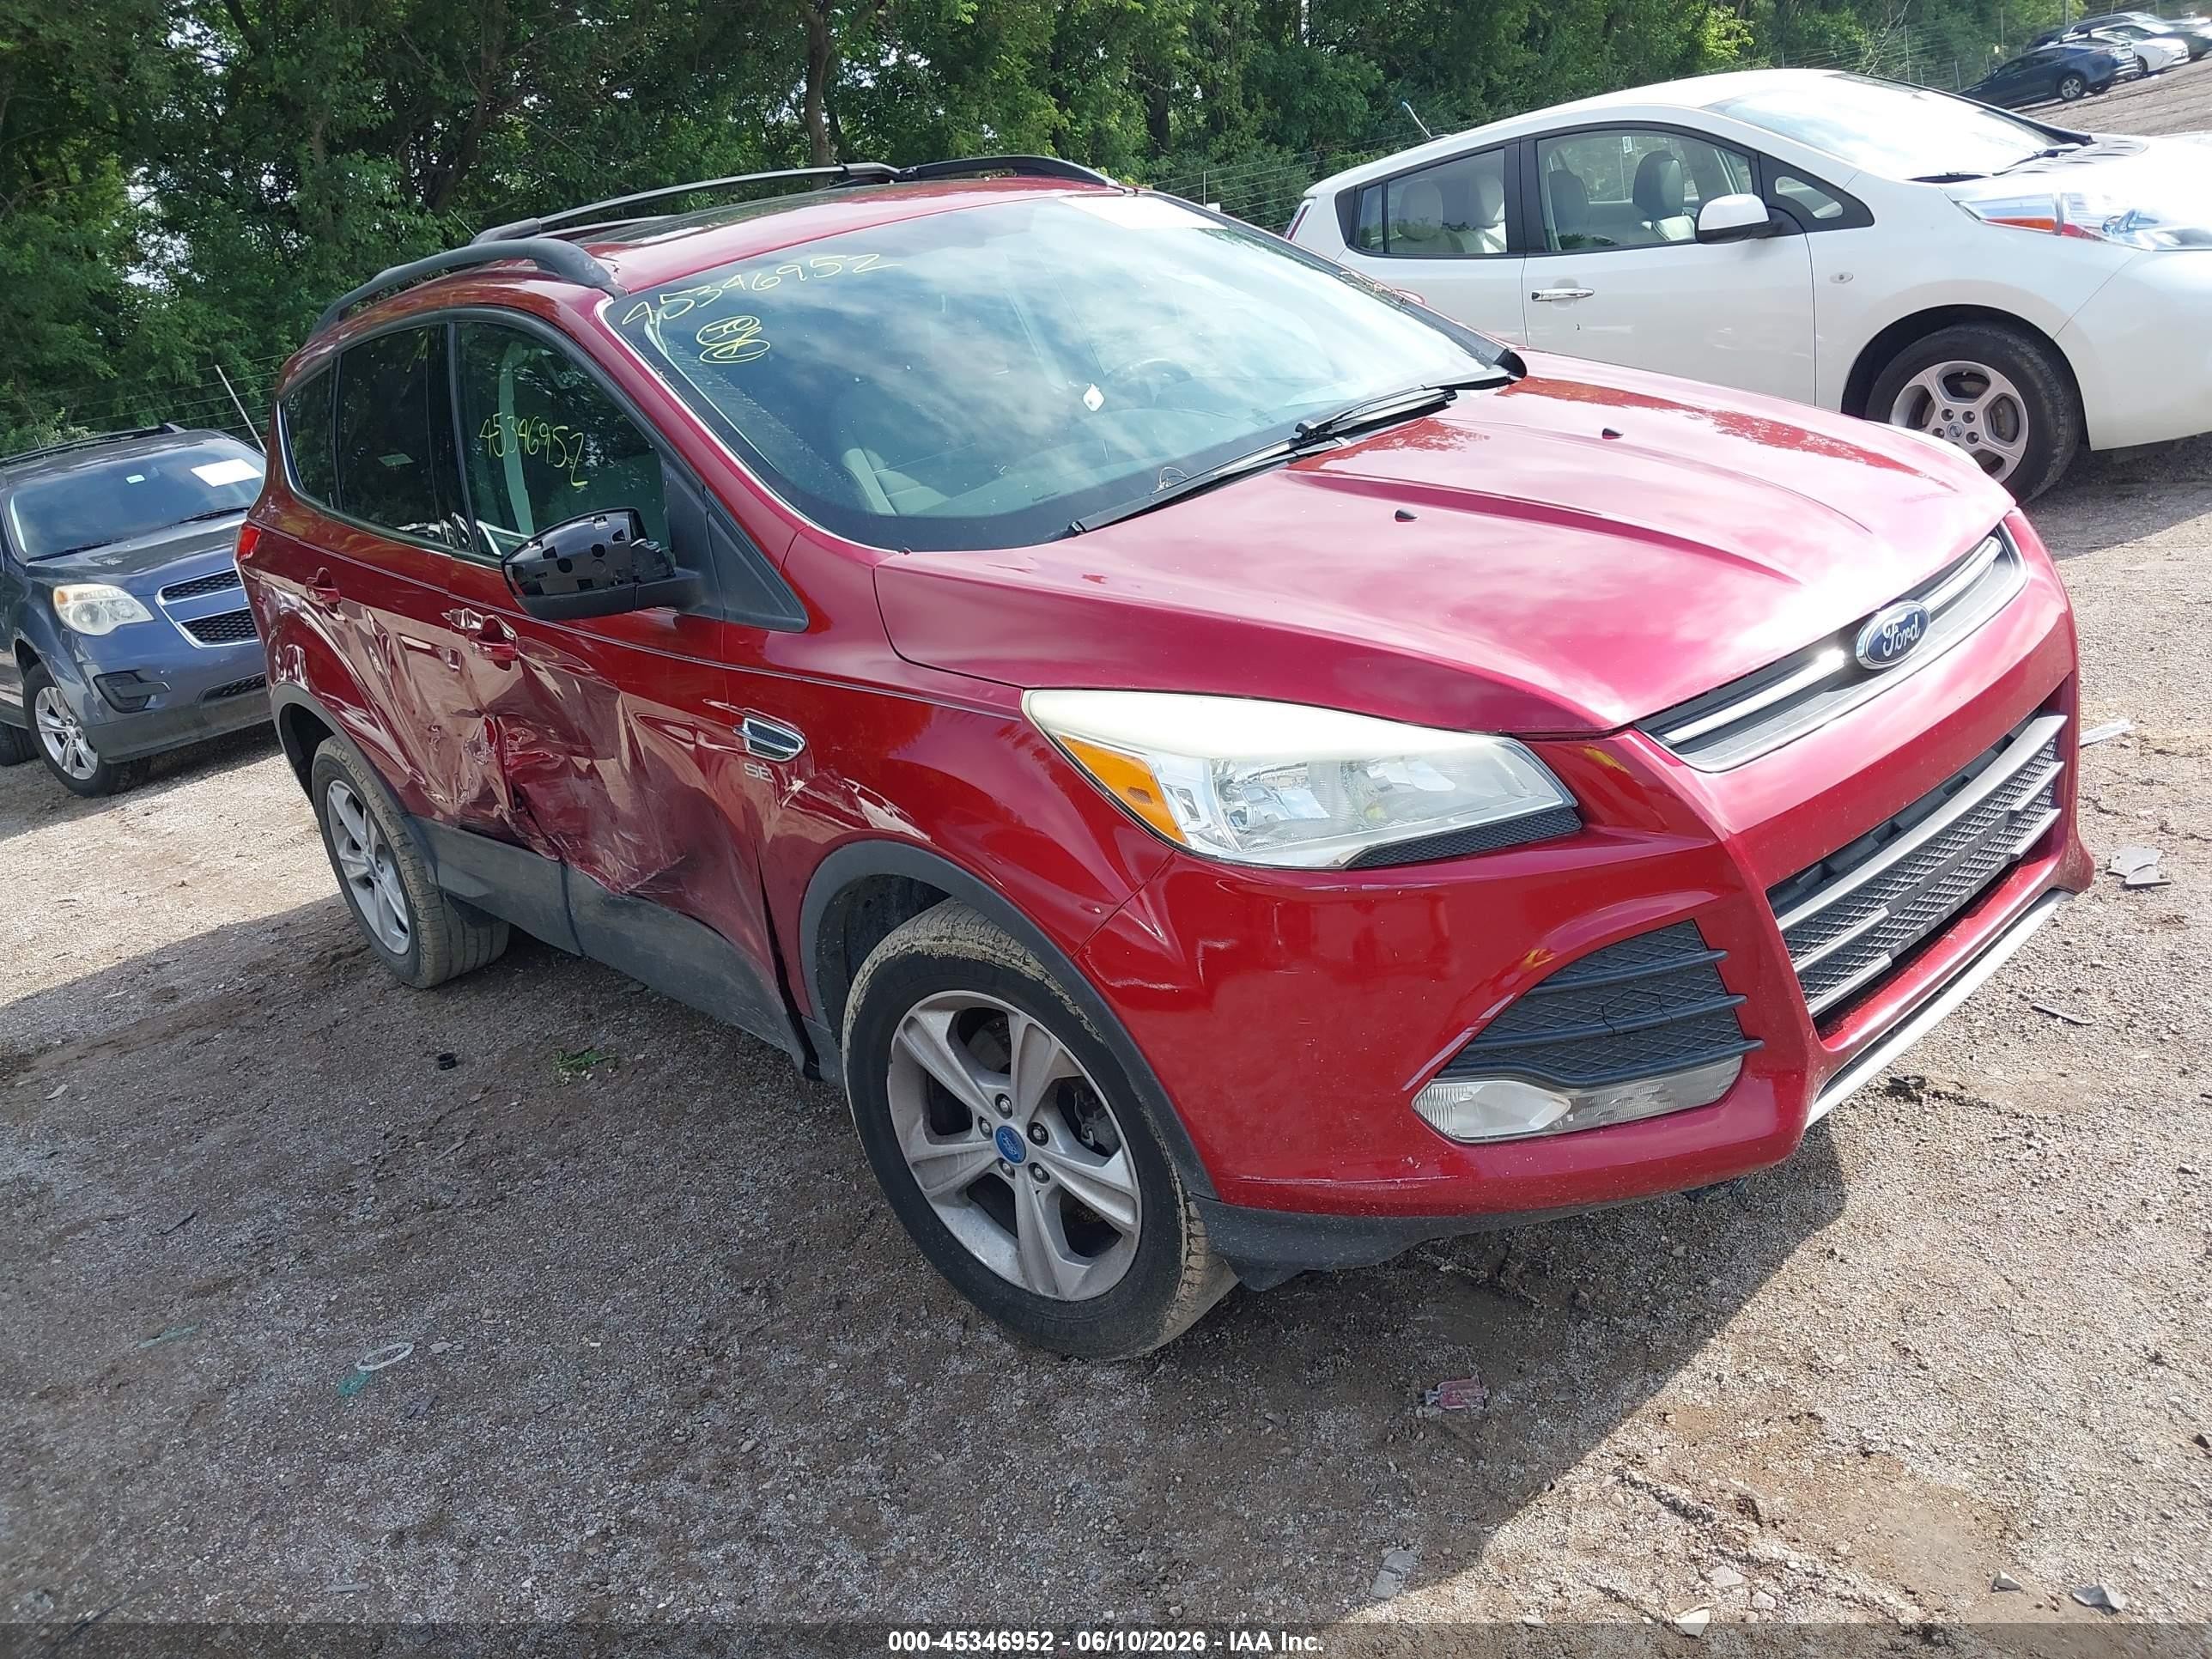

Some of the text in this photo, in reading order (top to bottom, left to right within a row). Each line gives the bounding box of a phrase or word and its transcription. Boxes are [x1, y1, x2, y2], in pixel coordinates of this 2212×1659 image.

[479, 412, 589, 487] 45346952
[1882, 613, 1922, 657] Ford
[744, 762, 774, 783] SE
